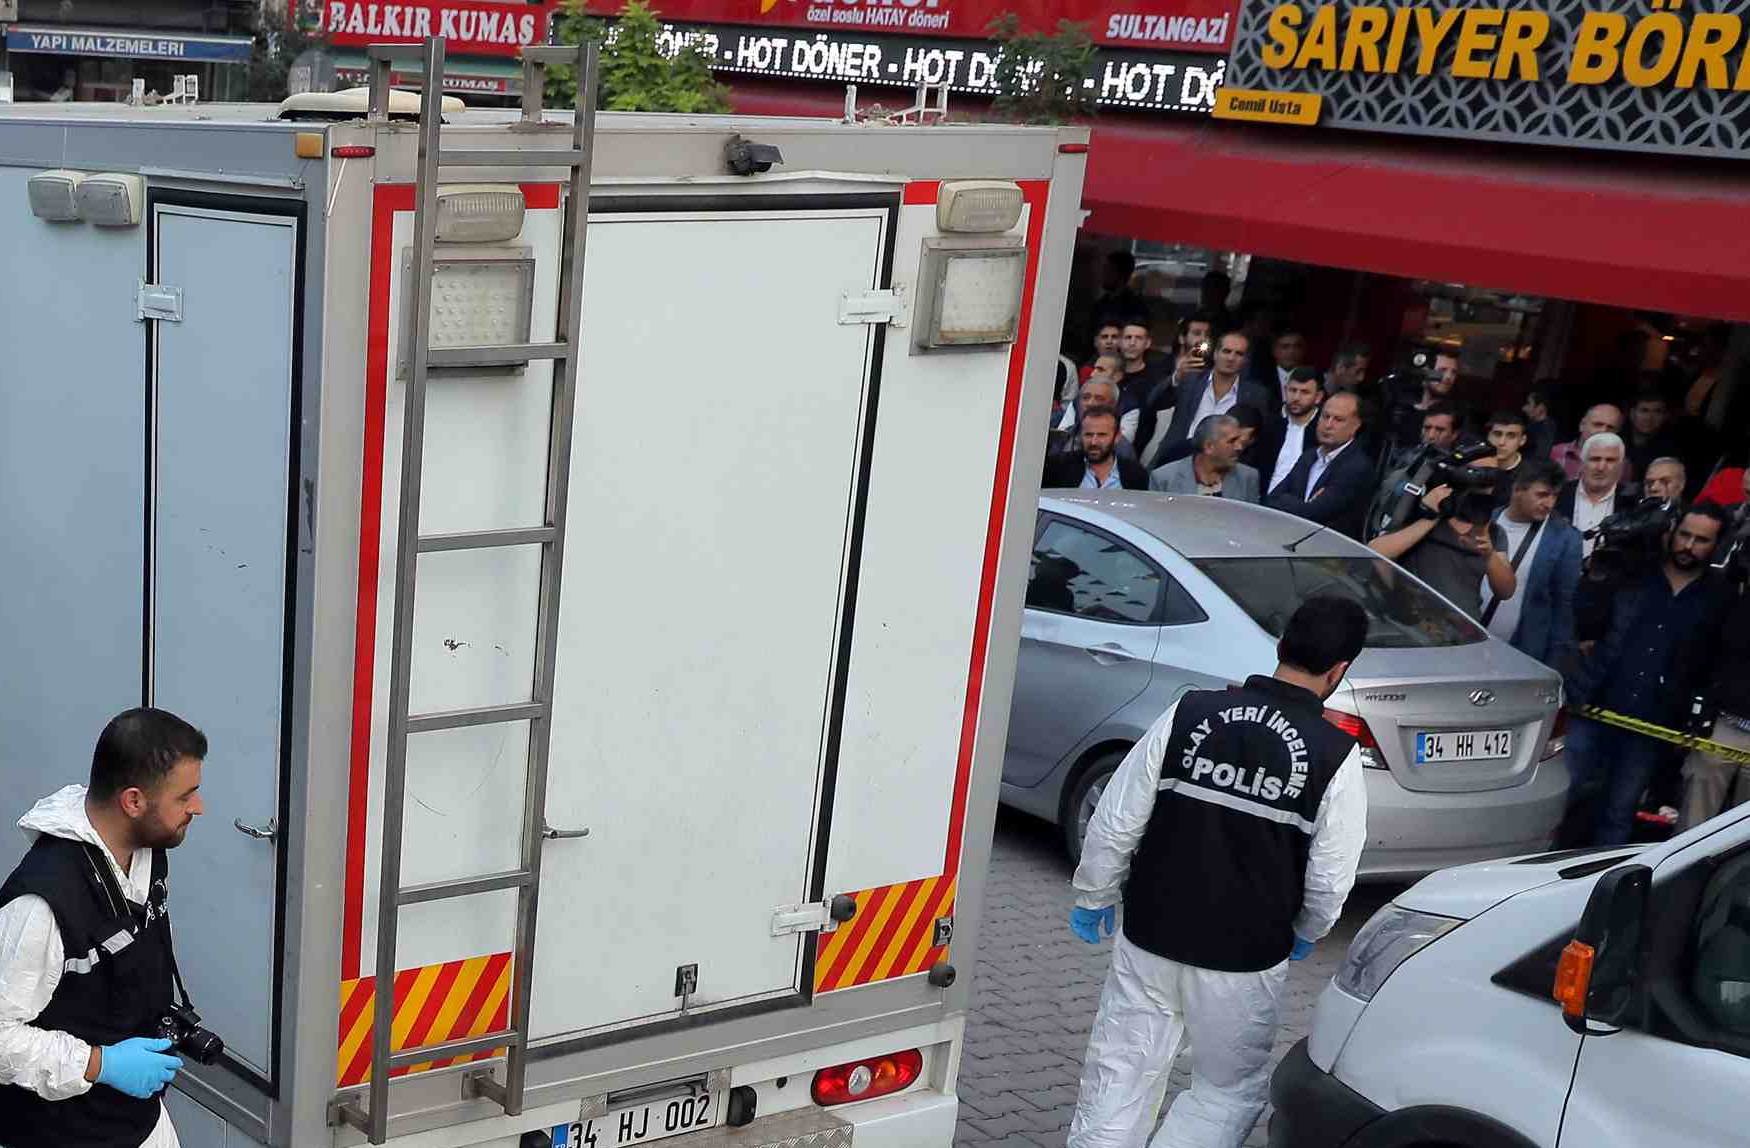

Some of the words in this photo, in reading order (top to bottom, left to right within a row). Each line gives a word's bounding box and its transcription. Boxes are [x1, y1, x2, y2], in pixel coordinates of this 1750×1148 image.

[329, 1, 432, 38] BALKIR
[807, 6, 830, 22] özel
[833, 9, 864, 25] soslu
[865, 9, 907, 27] HATAY
[908, 11, 949, 29] döneri
[1106, 13, 1230, 44] SULTANGAZİ
[31, 34, 67, 50] YAPI
[737, 36, 787, 70] HOT
[791, 34, 881, 78] DÖNER
[902, 47, 964, 86] HOT
[1262, 3, 1551, 82] SARIYER
[1101, 61, 1176, 102] HOT
[1269, 99, 1302, 115] Usta
[1182, 718, 1213, 769] OLAY
[1218, 705, 1268, 724] YERİ
[1266, 709, 1309, 799] İNCELEME
[1425, 736, 1443, 758] 34
[1456, 735, 1474, 756] HH
[1484, 732, 1509, 755] 412
[1191, 757, 1283, 800] POLİS
[618, 1107, 650, 1142] HJ
[665, 1094, 710, 1132] 002
